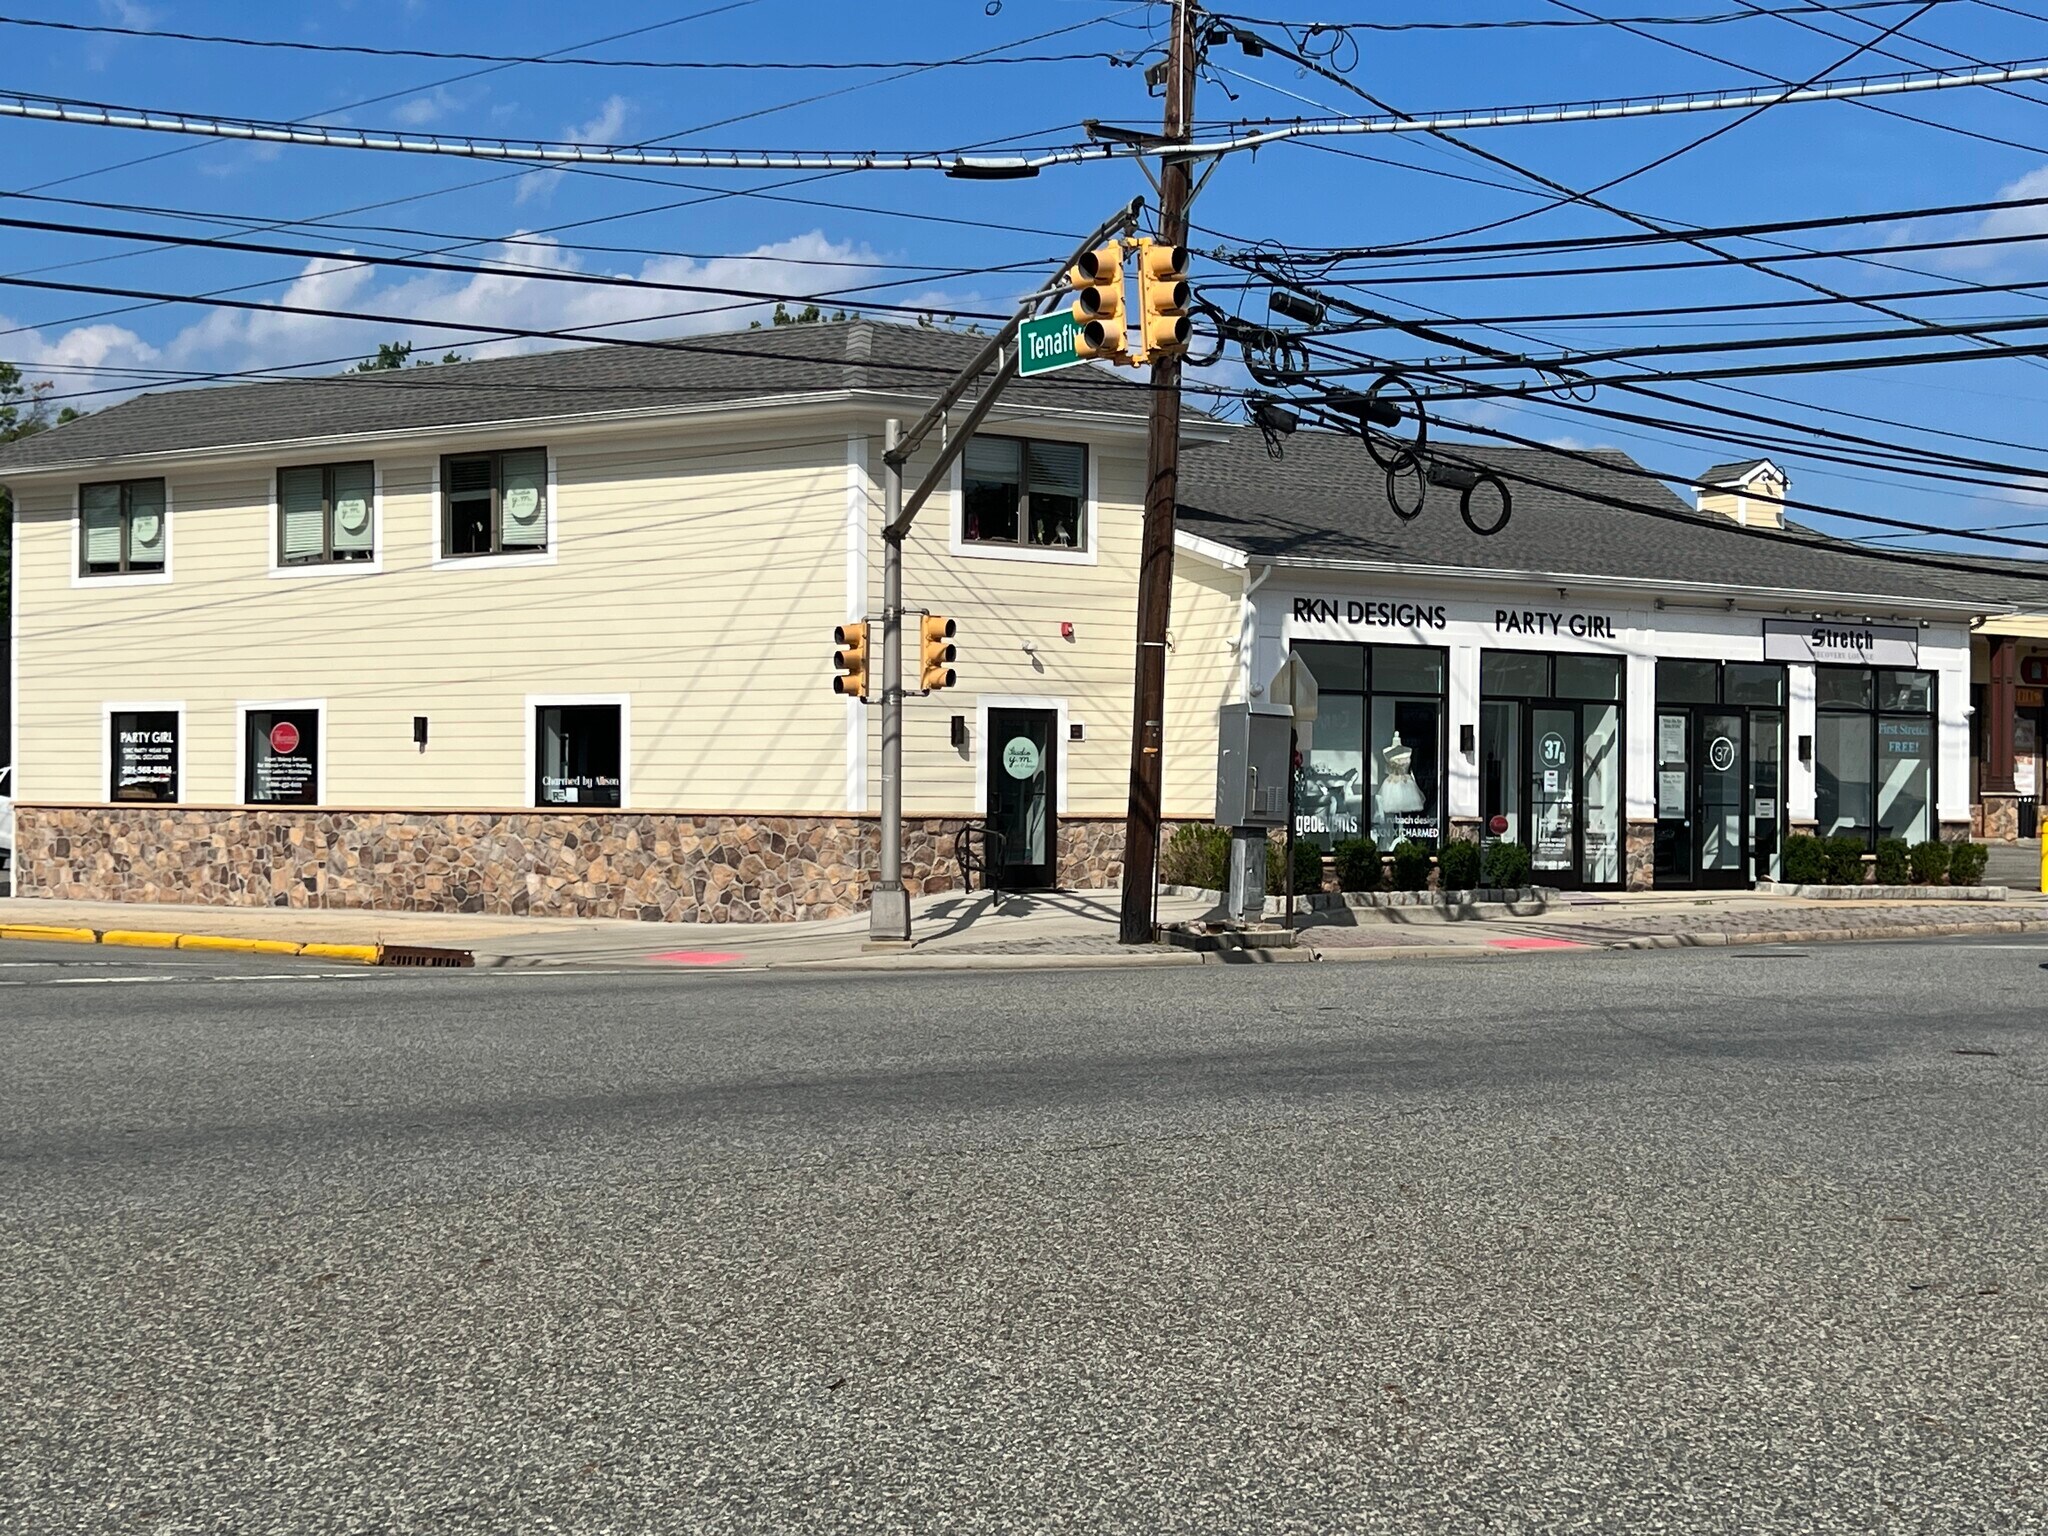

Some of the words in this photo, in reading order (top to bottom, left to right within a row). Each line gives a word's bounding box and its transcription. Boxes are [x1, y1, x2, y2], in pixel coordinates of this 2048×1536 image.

[1293, 597, 1339, 624] RKN
[1347, 601, 1447, 630] DESIGNS
[1495, 610, 1563, 635] PARTY
[1568, 614, 1616, 639] GIRL
[1811, 628, 1874, 650] Stretch
[1847, 652, 1874, 660] LOUGE
[1879, 722, 1898, 734] First
[120, 731, 150, 743] PARTY
[151, 731, 174, 743] GIRL
[1888, 741, 1919, 752] FREE!
[1715, 746, 1730, 761] 37
[542, 776, 580, 786] Charmed
[582, 776, 593, 788] by
[595, 776, 619, 786] Alison
[1400, 828, 1439, 838] CHARMED
